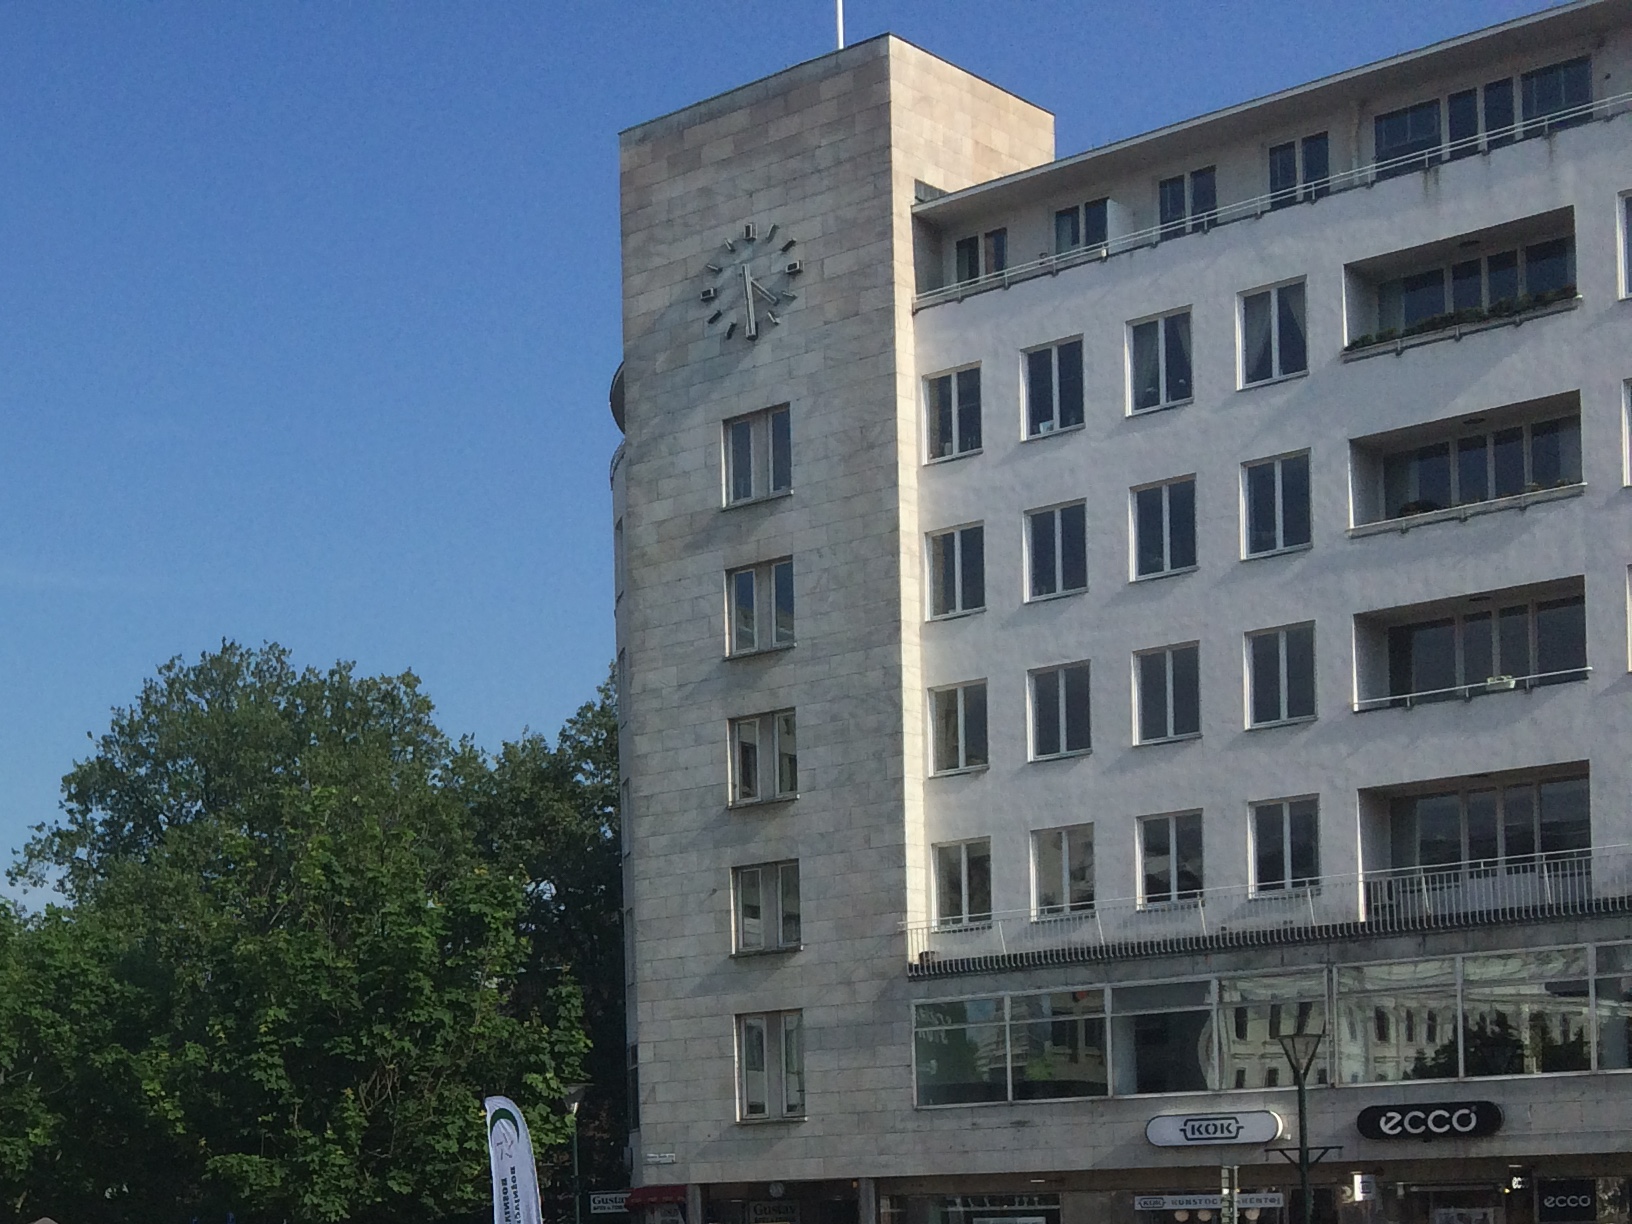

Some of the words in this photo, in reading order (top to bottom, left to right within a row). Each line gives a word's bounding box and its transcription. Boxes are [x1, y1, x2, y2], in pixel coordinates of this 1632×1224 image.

[1188, 1120, 1235, 1137] KOK
[1379, 1107, 1478, 1136] ecco
[592, 1195, 626, 1205] Gusta
[1543, 1195, 1591, 1208] ecco
